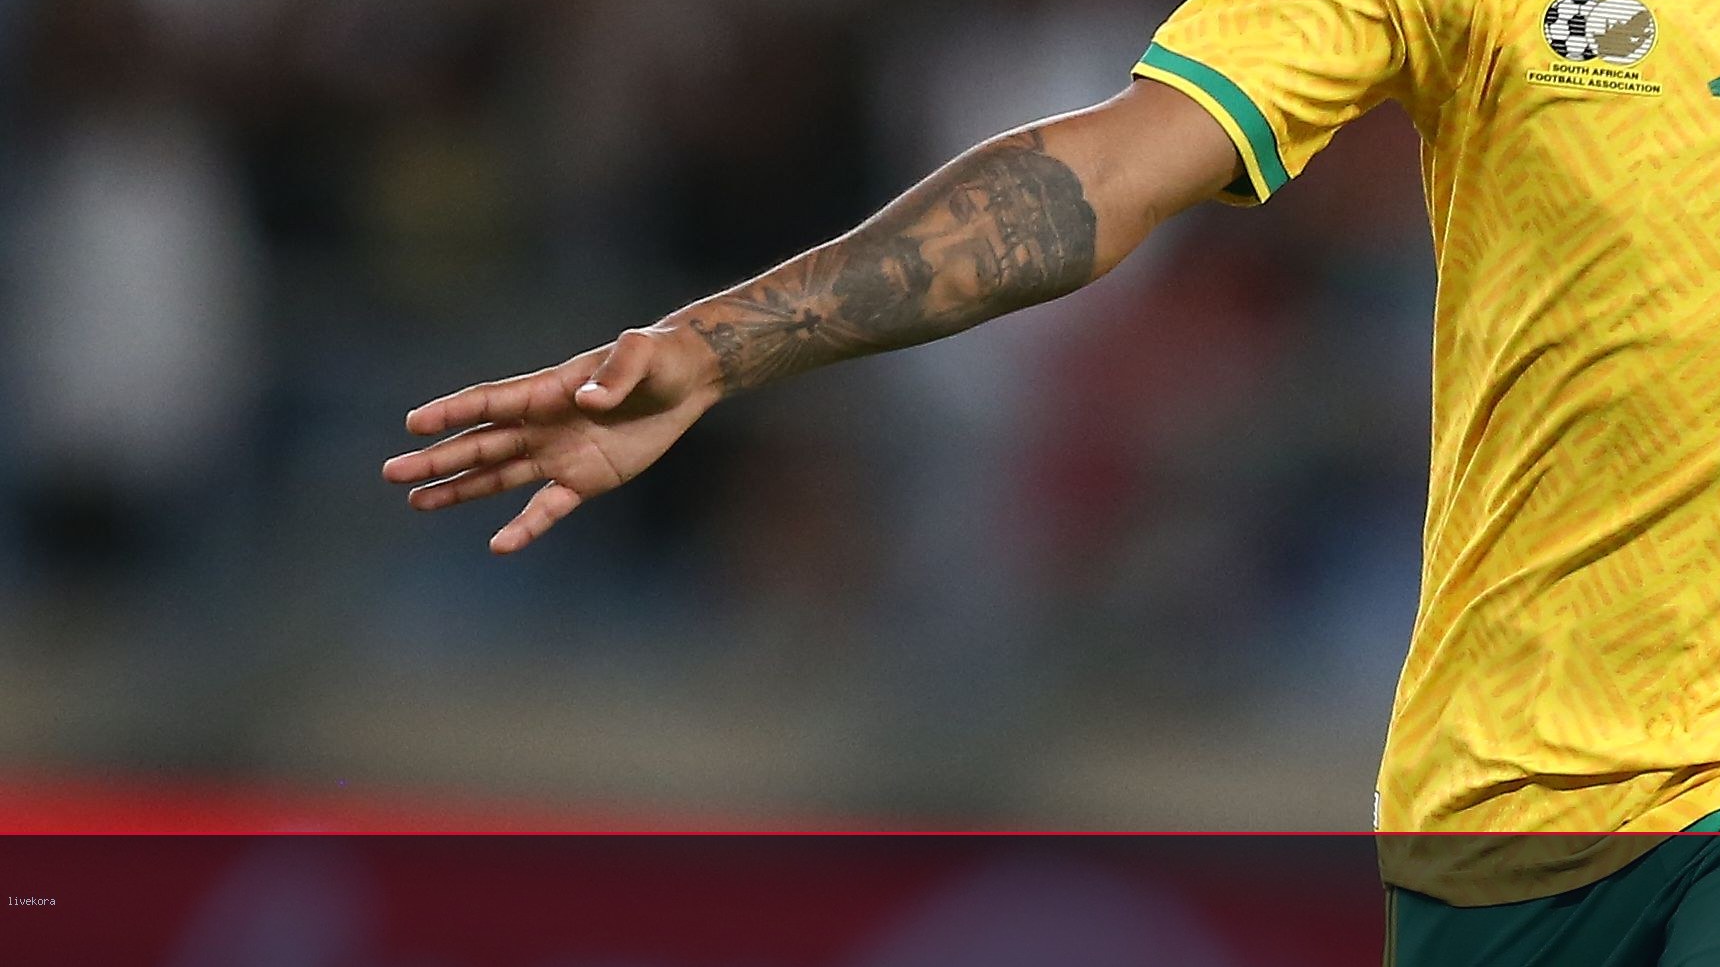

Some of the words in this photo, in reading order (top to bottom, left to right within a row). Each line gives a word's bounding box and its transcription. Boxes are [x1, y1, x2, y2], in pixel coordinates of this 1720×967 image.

[1552, 63, 1590, 76] SOUTH
[1592, 68, 1639, 80] AFRICAN
[1529, 72, 1585, 86] FOOTBALL
[1588, 77, 1661, 94] ASSOCIATION
